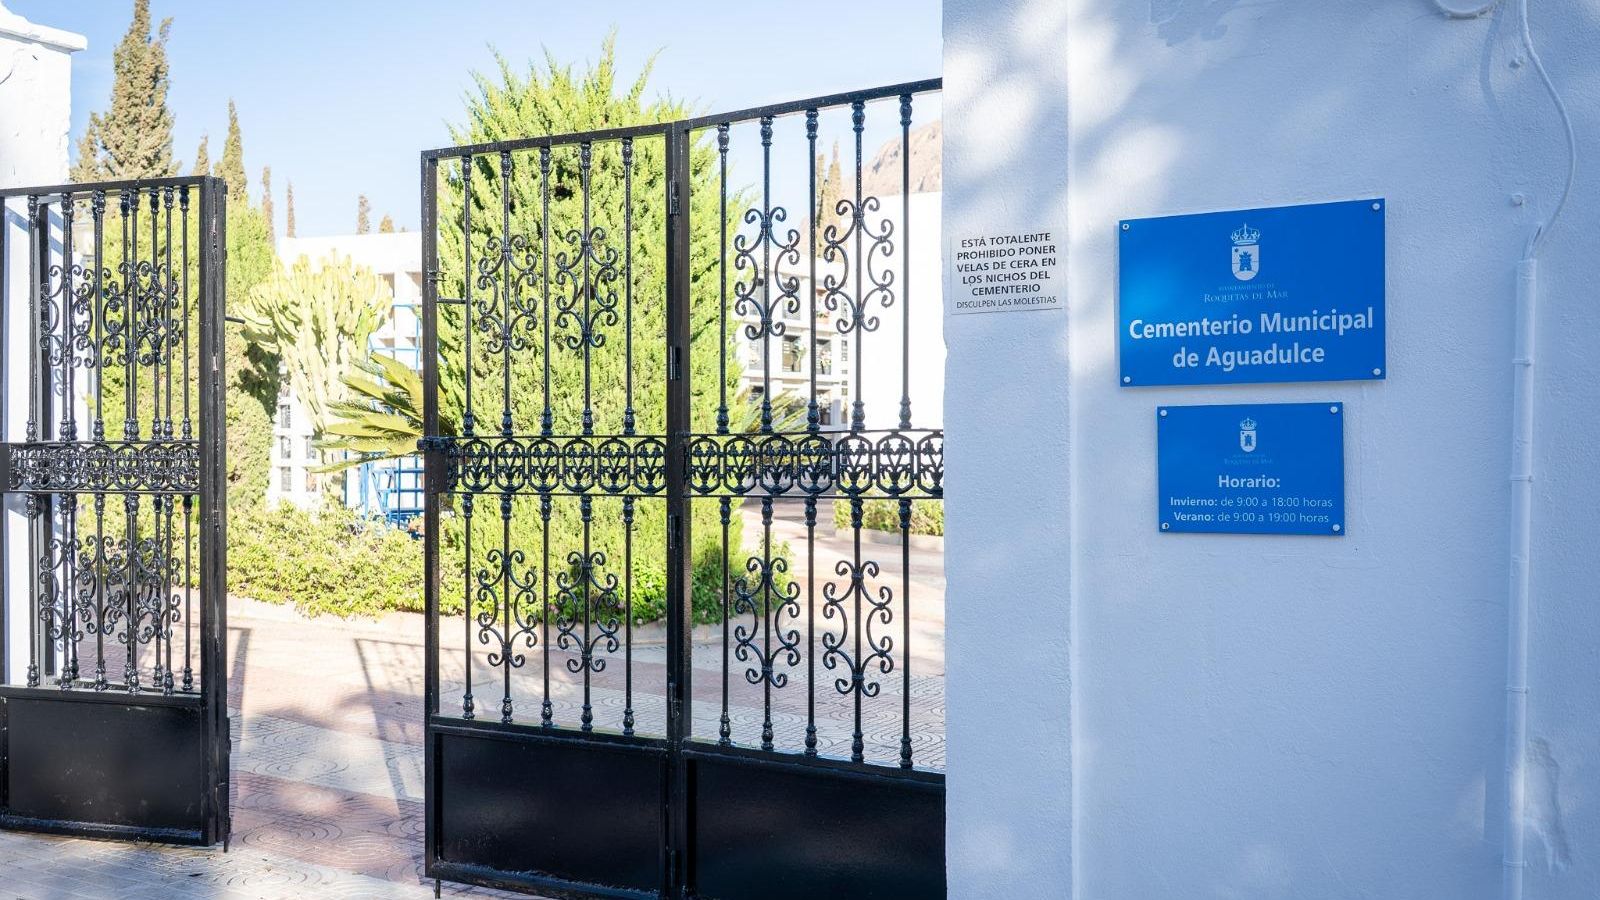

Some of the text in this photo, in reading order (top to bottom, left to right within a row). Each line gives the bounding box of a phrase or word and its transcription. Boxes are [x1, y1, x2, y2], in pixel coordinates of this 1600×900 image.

[961, 233, 1051, 248] ESTÁ TOTALENTE
[957, 245, 1056, 260] PROHIBIDO PONER
[956, 257, 1056, 273] VELAS DE CERA EN
[962, 271, 1050, 285] LOS NICHOS DEL
[972, 283, 1040, 296] CEMENTERIO
[956, 296, 1057, 309] DISCULPEN LAS MOLESTIAS
[1129, 306, 1373, 339] Cementerio Municipal
[1173, 342, 1325, 372] de Aguadulce
[1218, 474, 1281, 488] Horario:
[1170, 496, 1333, 508] Invierno: de 9:00 a 18:00 horas
[1173, 511, 1329, 523] Verano: de 9:00 a 19:00 horas
